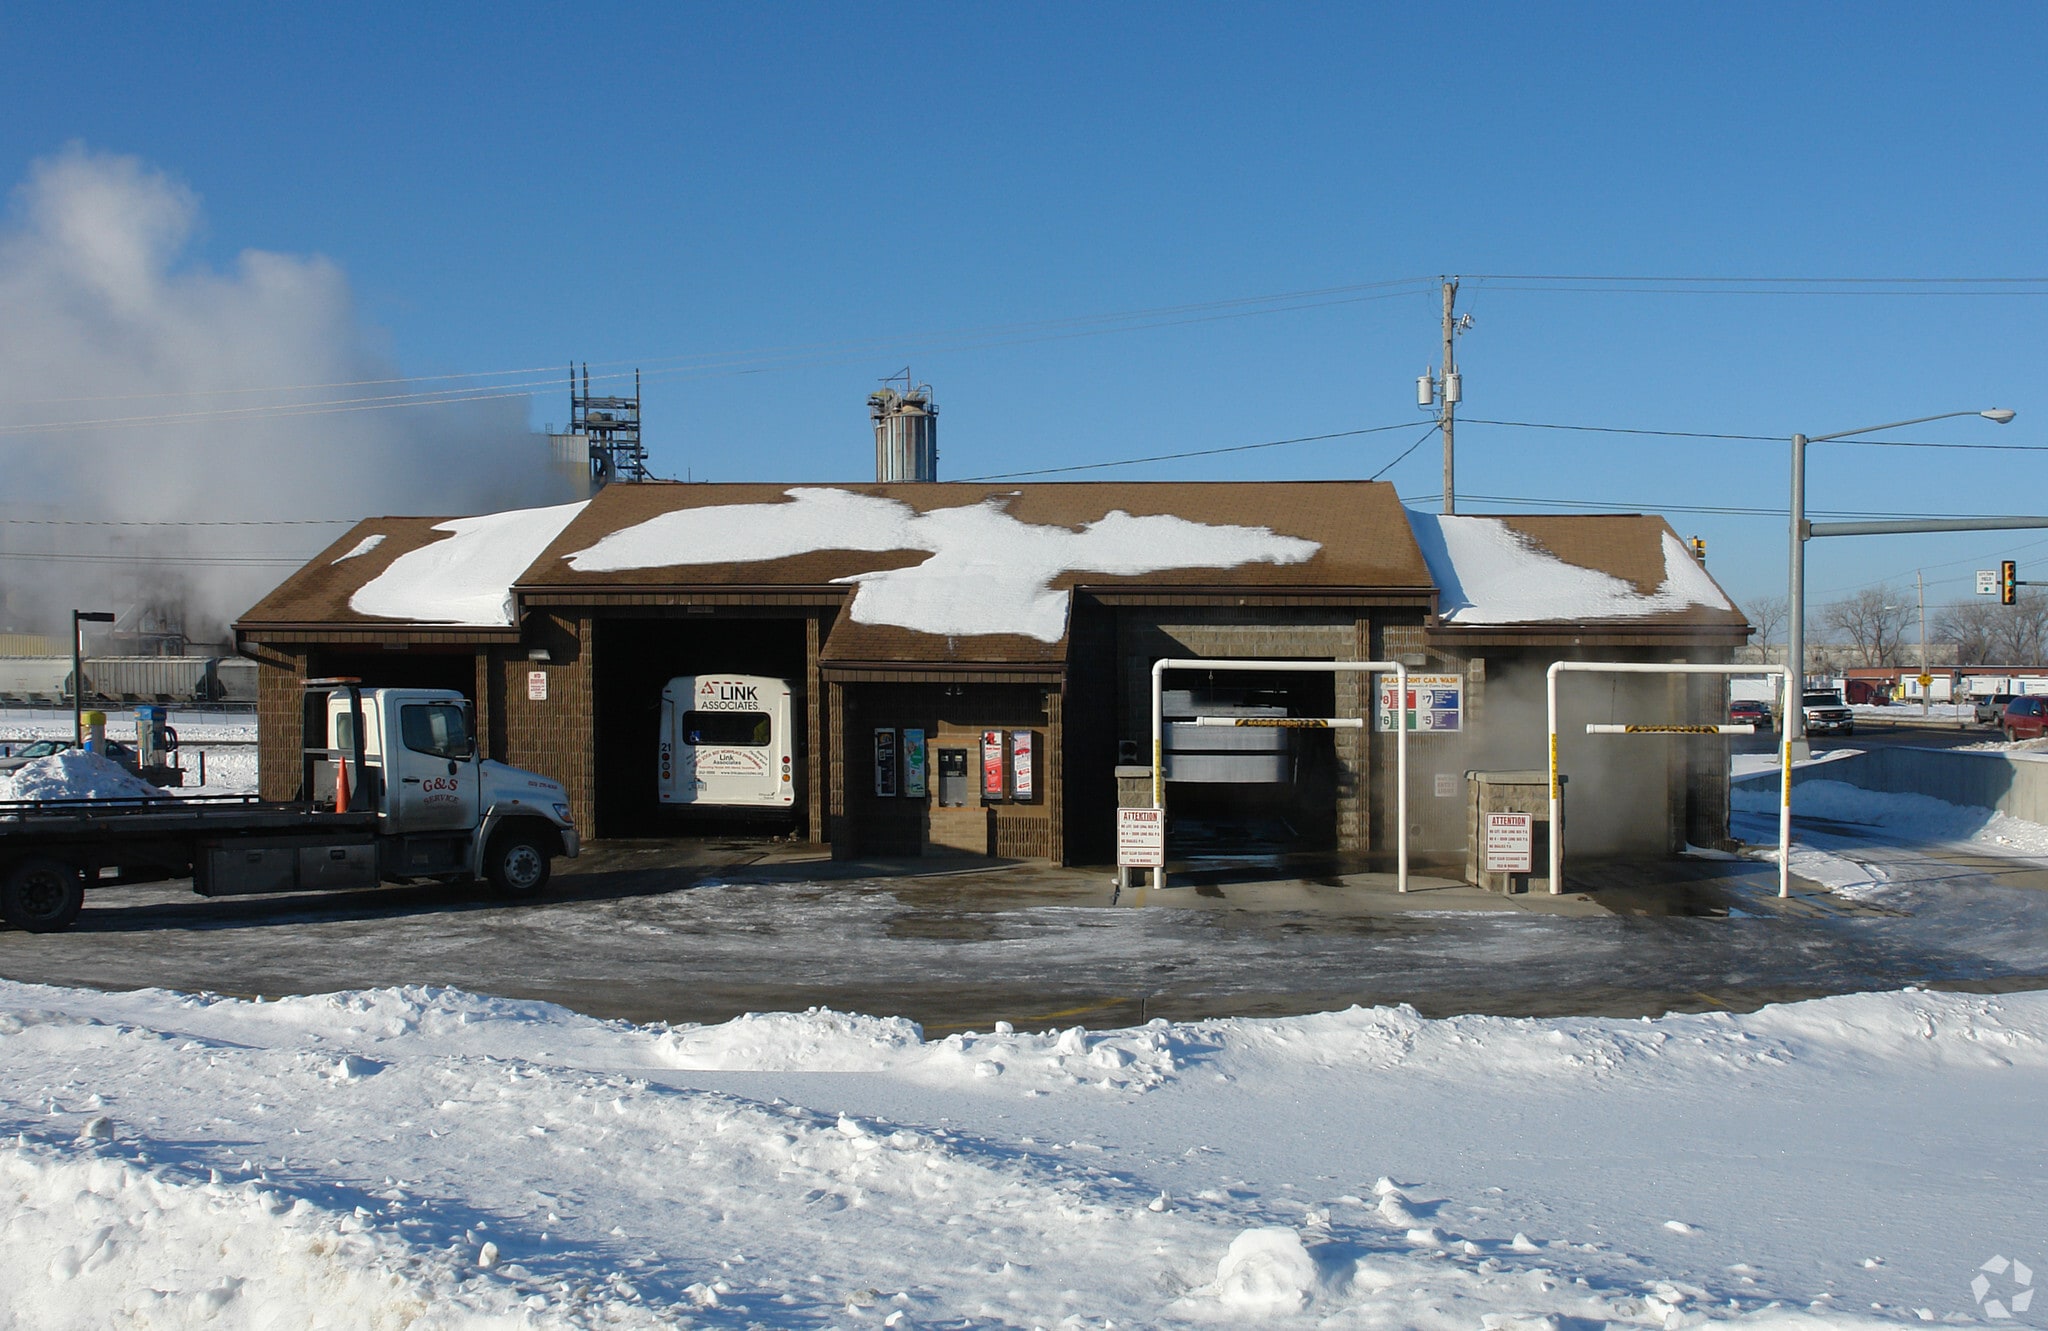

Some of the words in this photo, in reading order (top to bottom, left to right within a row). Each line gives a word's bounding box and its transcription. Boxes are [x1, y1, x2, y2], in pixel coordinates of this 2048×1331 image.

[720, 686, 758, 701] LINK
[701, 700, 759, 711] ASSOCIATES
[661, 743, 671, 752] 21
[423, 777, 458, 792] G&S
[423, 794, 460, 806] SERVICE
[1123, 812, 1158, 821] ATTENTION
[1492, 816, 1526, 825] ATTENTION
